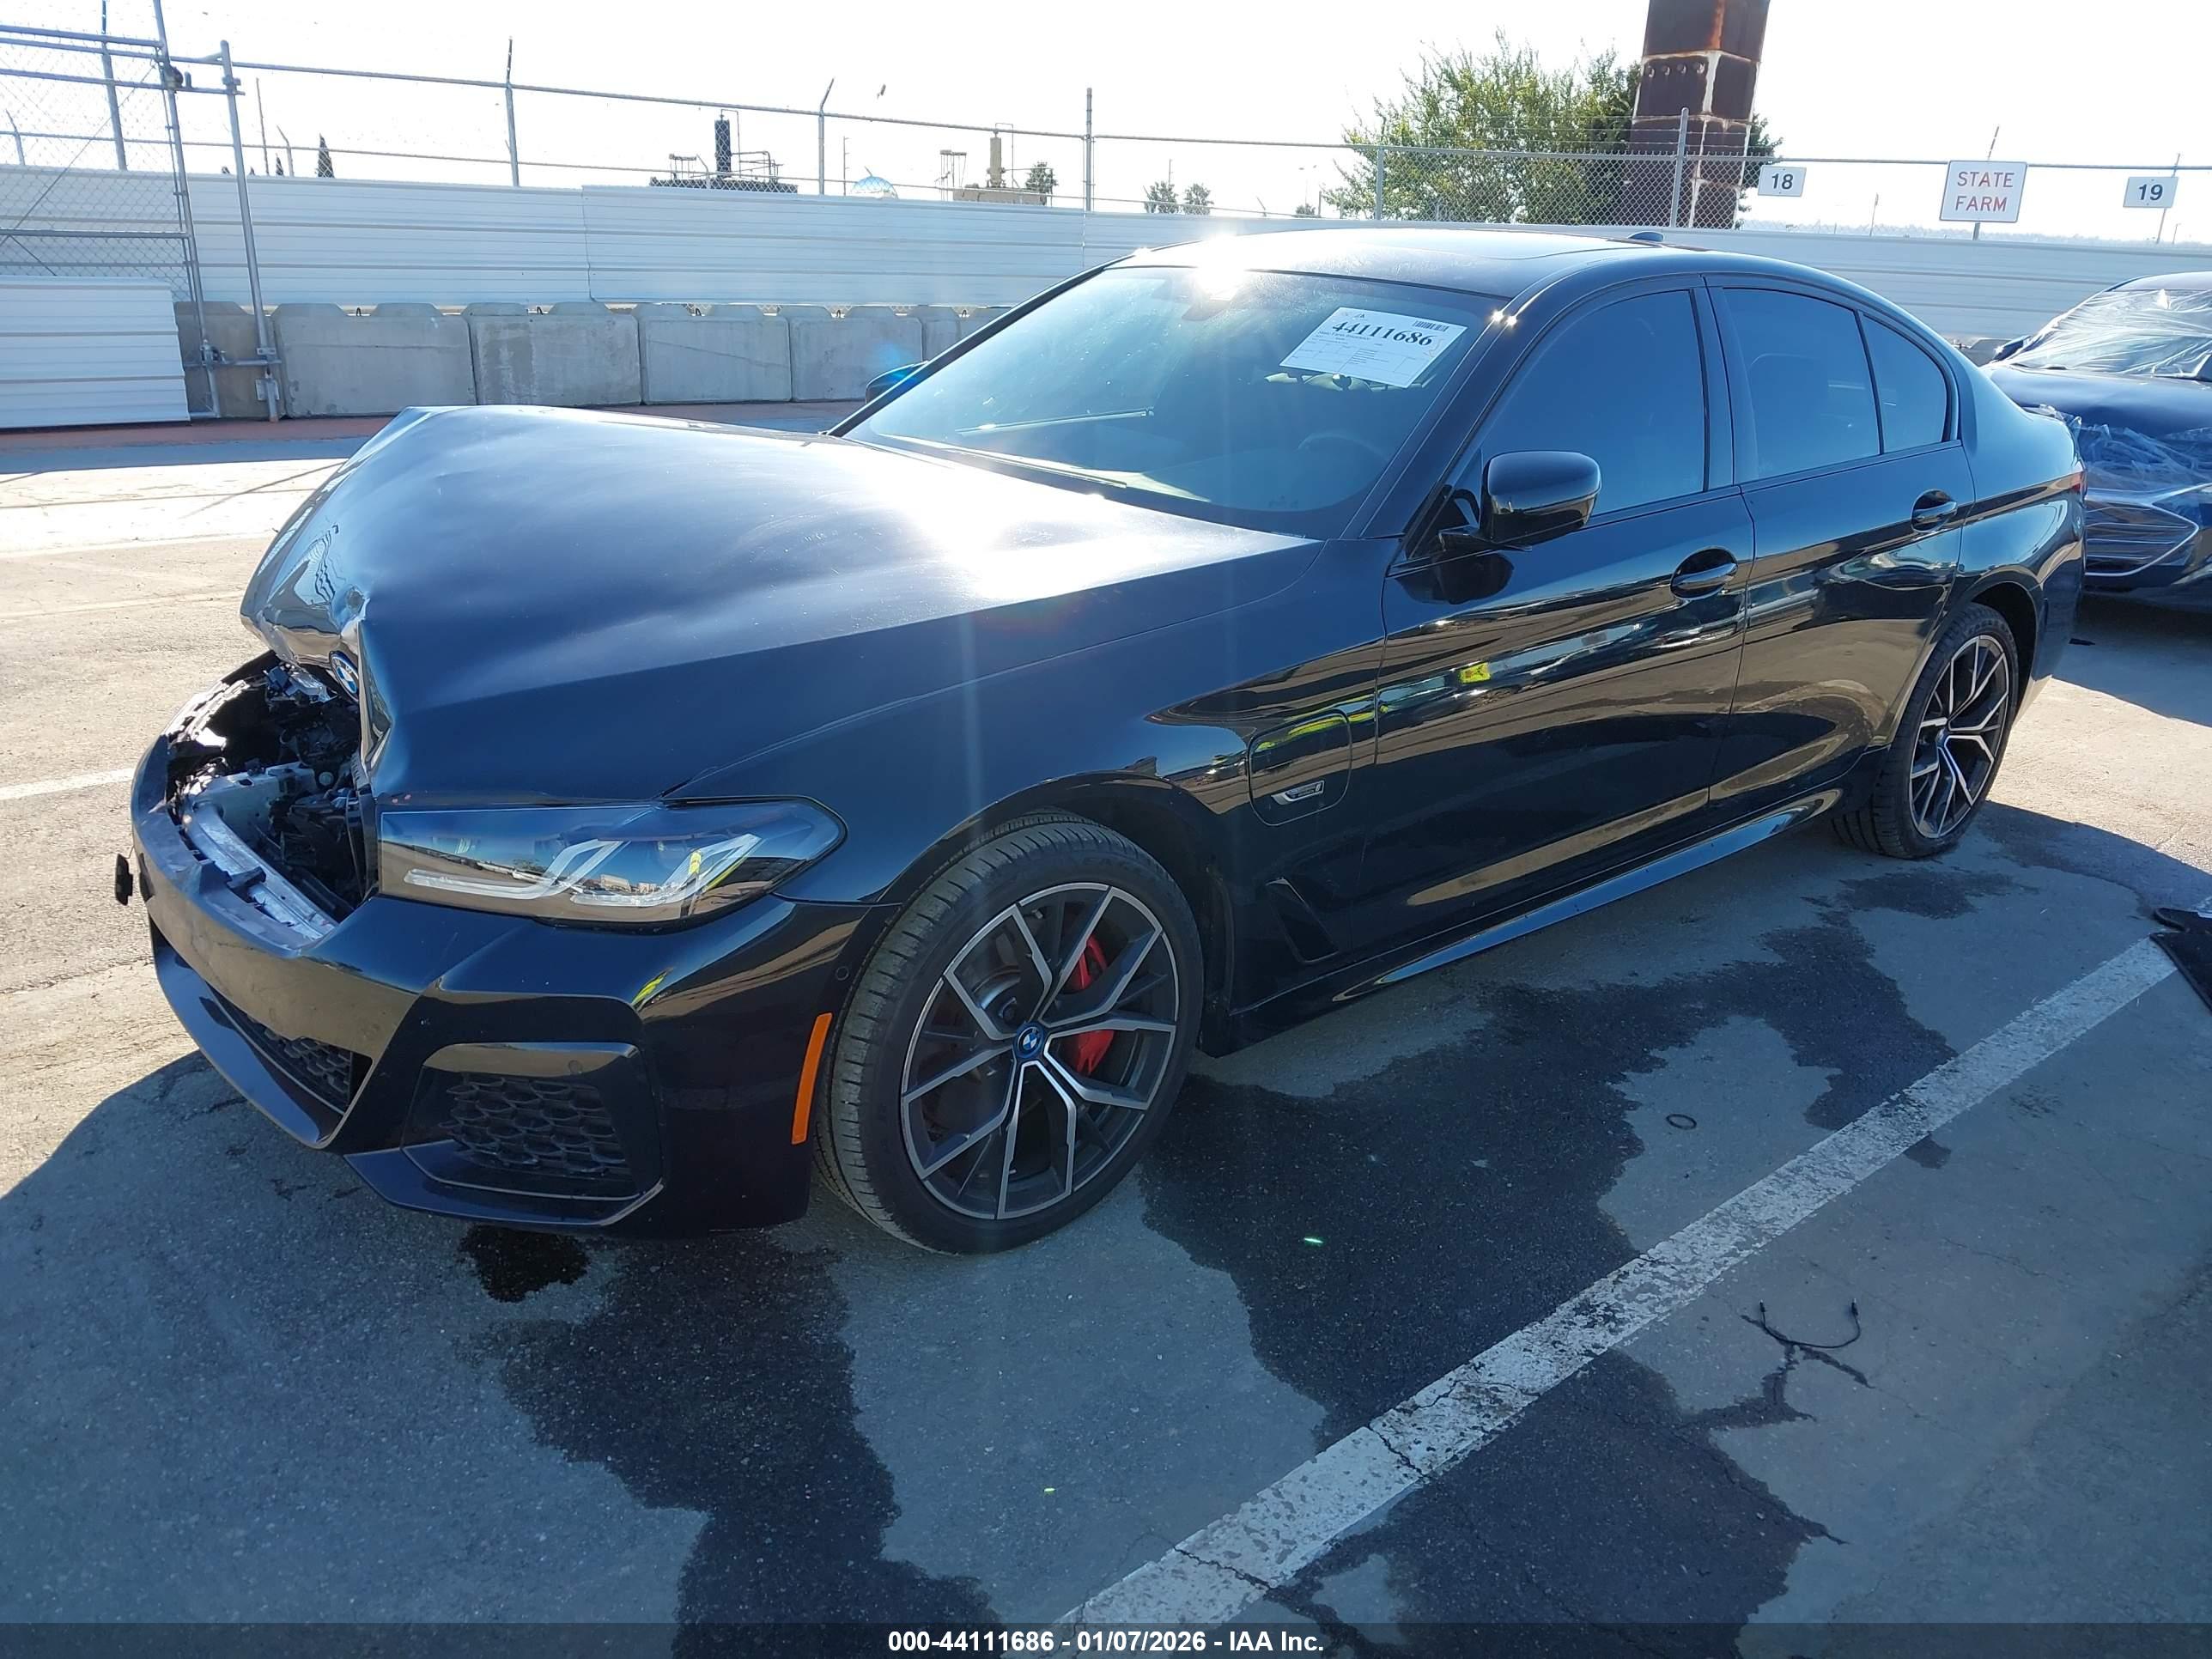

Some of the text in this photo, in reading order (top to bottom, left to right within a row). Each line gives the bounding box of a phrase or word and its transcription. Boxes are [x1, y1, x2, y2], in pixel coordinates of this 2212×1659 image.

[1771, 173, 1794, 190] 18
[1957, 171, 2015, 188] STATE
[2138, 184, 2163, 201] 19
[1954, 195, 2008, 212] FARM
[1332, 321, 1437, 346] 44111686
